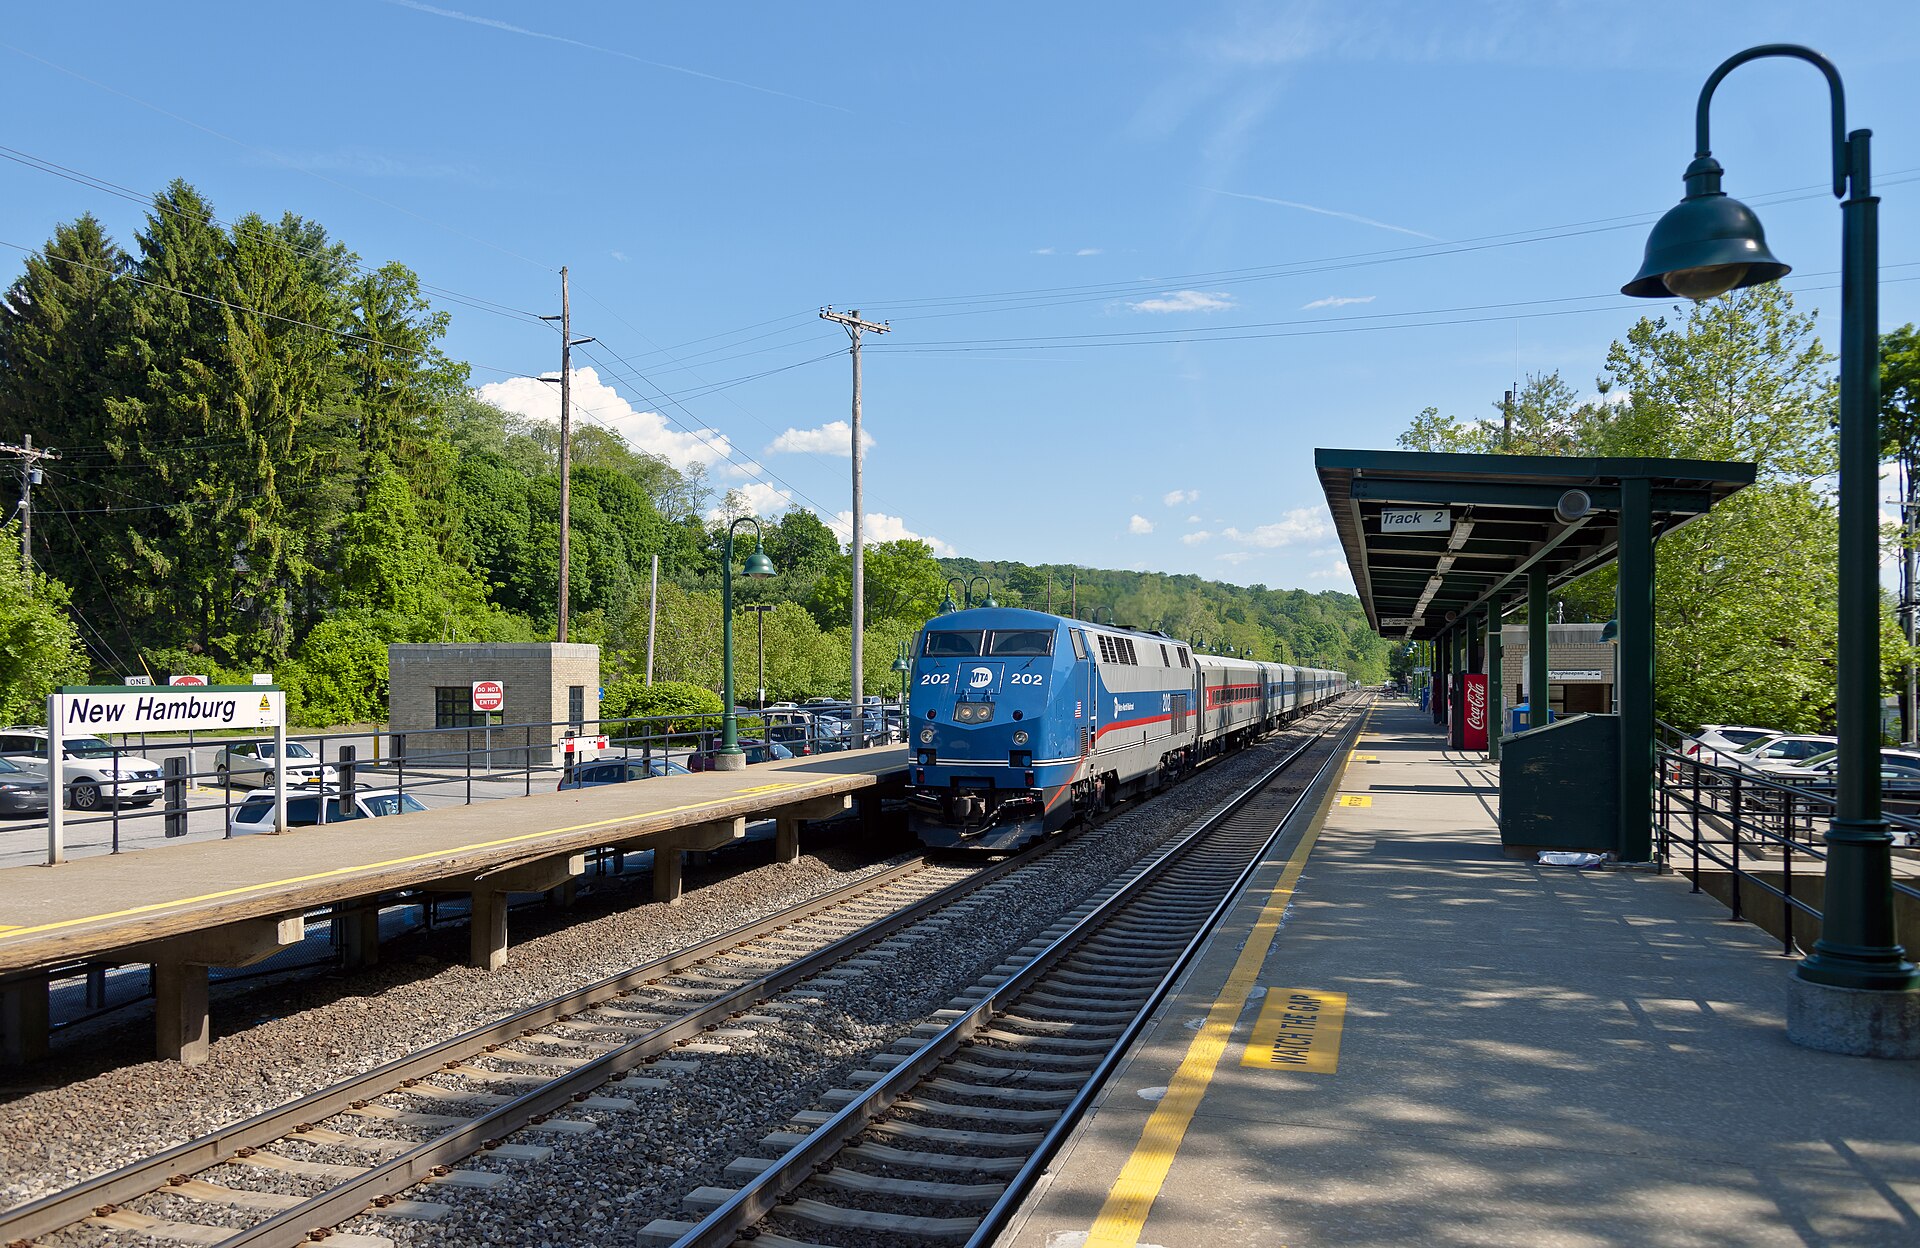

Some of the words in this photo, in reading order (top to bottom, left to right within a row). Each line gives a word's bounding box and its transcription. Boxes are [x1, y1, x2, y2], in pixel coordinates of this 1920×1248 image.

[1383, 512, 1422, 524] Track
[1433, 511, 1443, 523] 2
[921, 673, 950, 686] 202
[1011, 673, 1043, 686] 202
[69, 698, 126, 723] New
[135, 696, 236, 723] Hamburg
[1467, 681, 1485, 730] Coca-Cola
[1286, 994, 1322, 1012] GAP
[1280, 1013, 1317, 1030] THE
[1270, 1031, 1314, 1065] WATCH
